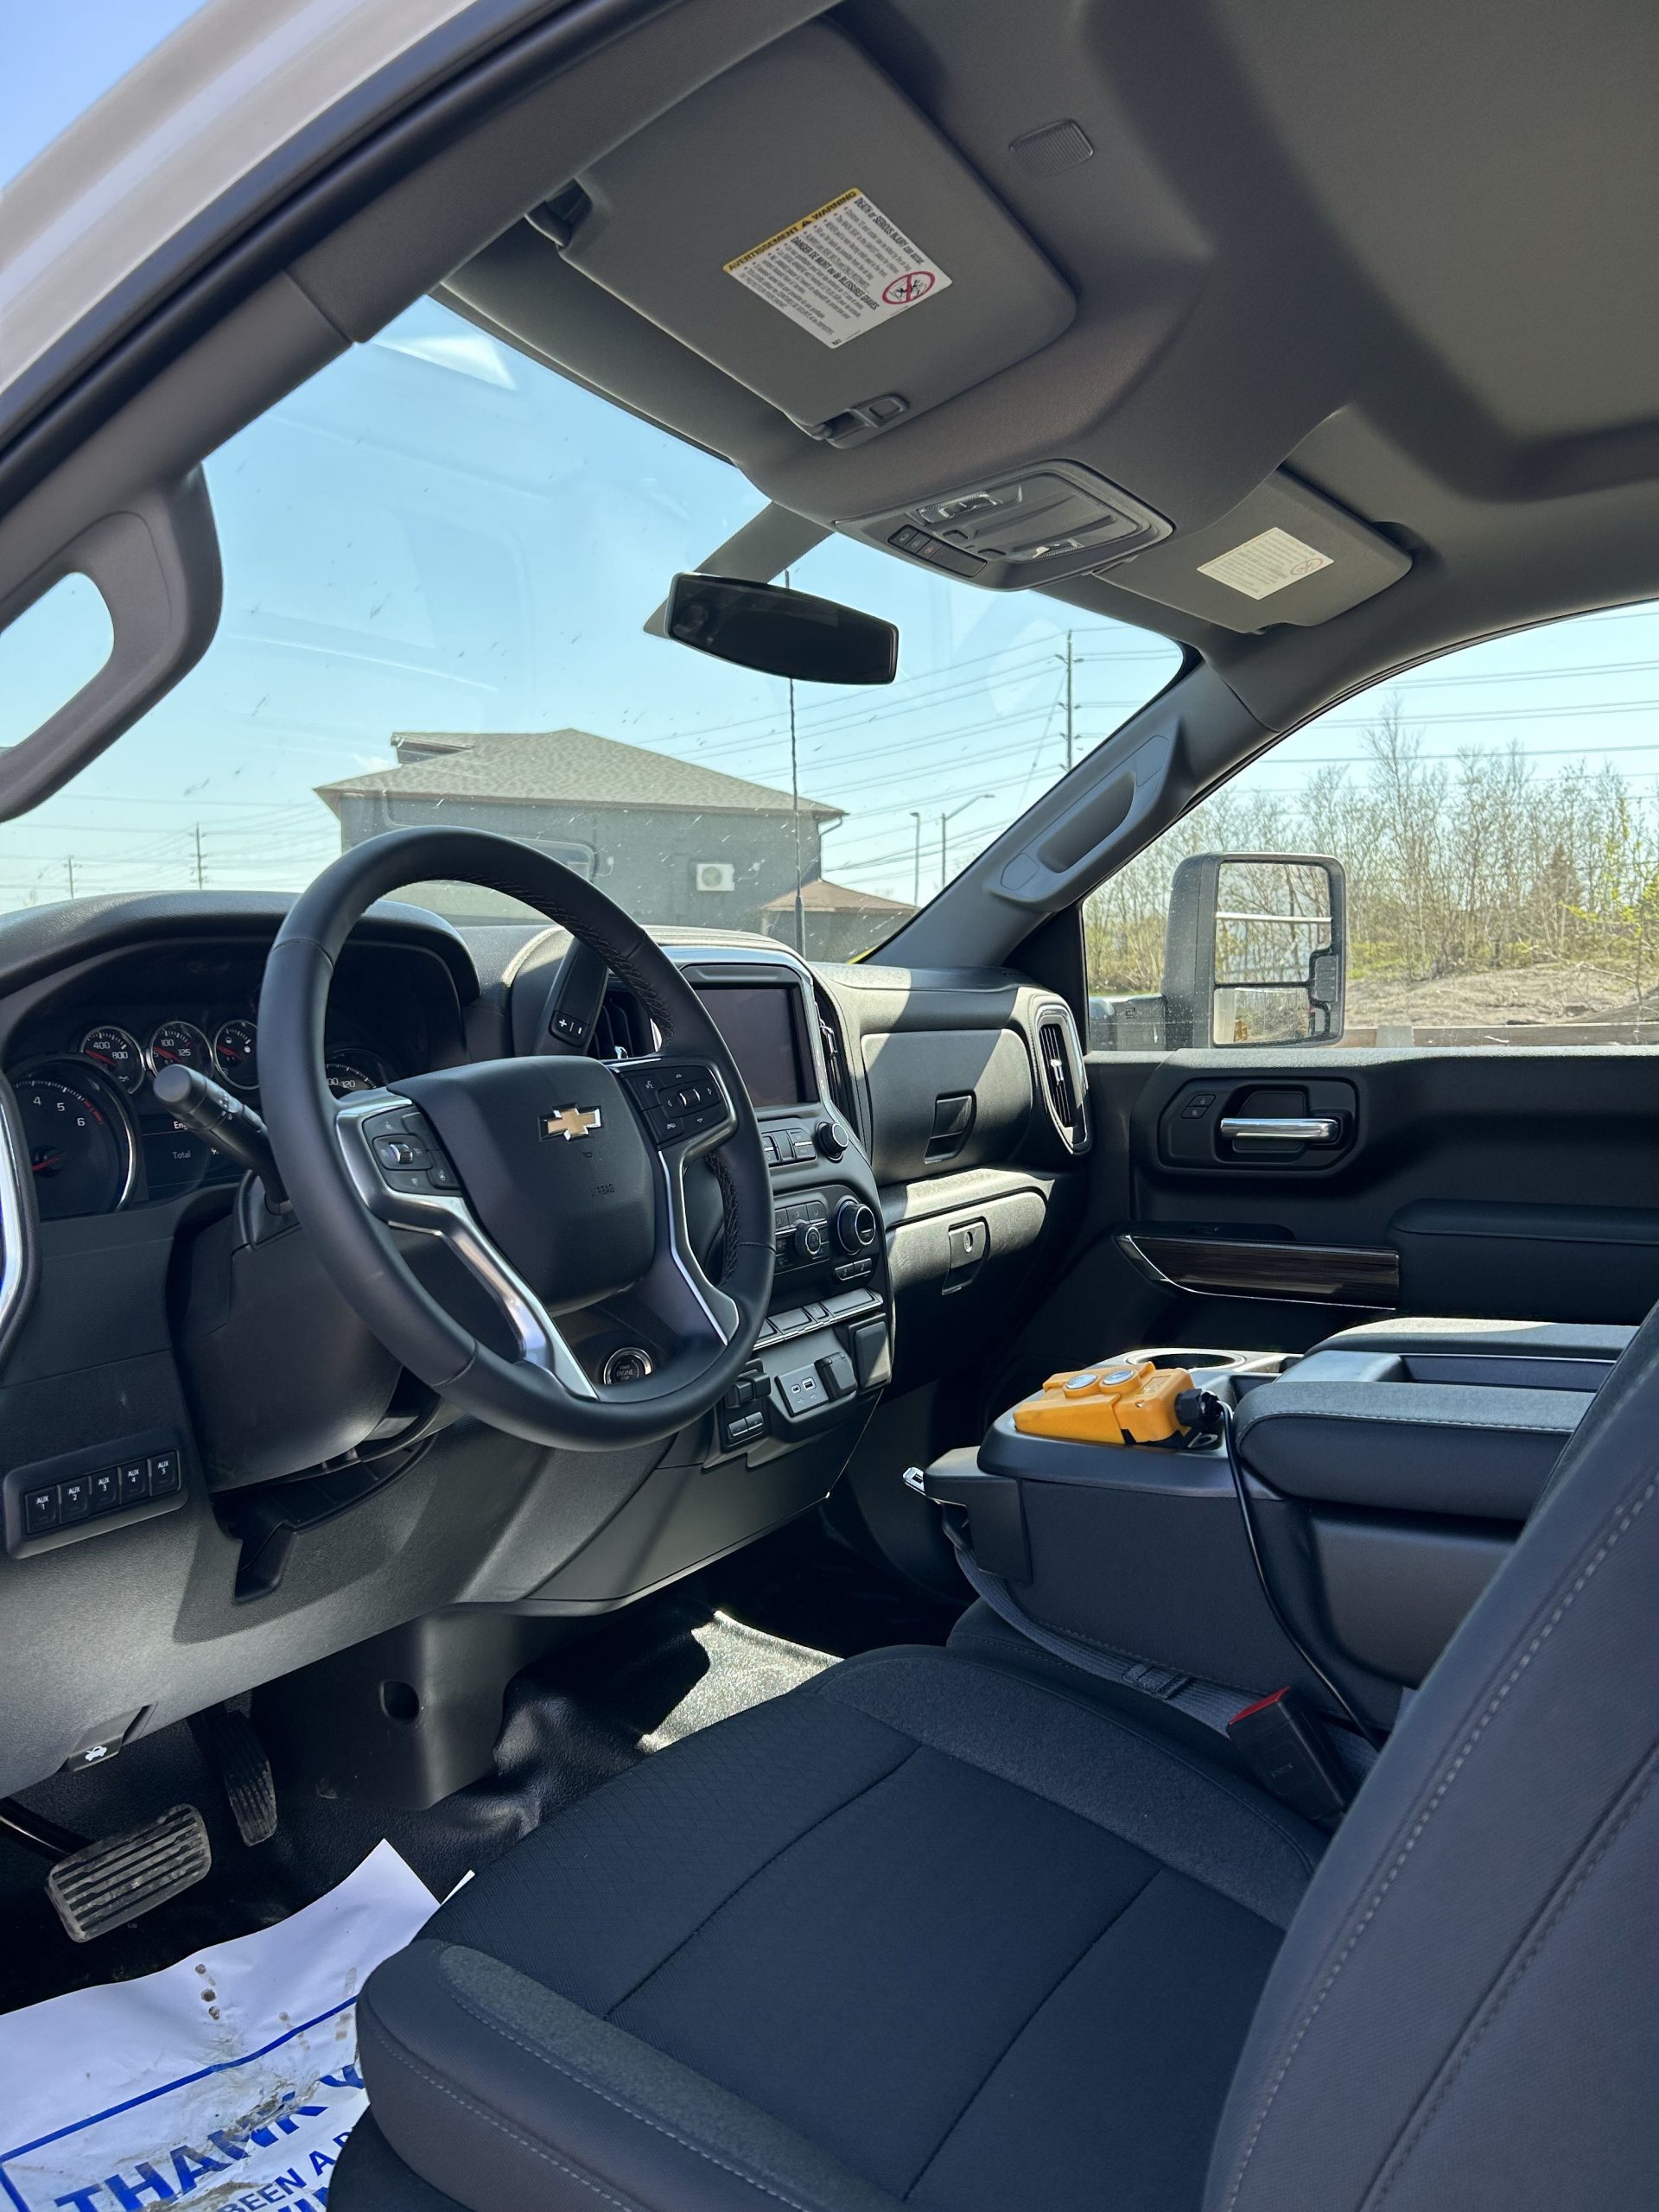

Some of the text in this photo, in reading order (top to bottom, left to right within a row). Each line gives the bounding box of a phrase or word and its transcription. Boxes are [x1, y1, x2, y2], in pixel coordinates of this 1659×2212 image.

[853, 197, 874, 214] DEATH
[871, 214, 895, 234] SERIOUS
[728, 227, 799, 270] AVERTISSEMENT
[811, 191, 857, 220] WARNING
[790, 236, 814, 254] DANGER
[92, 1041, 111, 1050] 400
[161, 1039, 175, 1047] 100
[111, 1051, 128, 1060] 800
[178, 1048, 192, 1057] 125
[341, 1080, 356, 1089] 120
[33, 1096, 42, 1106] 4
[56, 1102, 66, 1112] 5
[77, 1117, 86, 1127] 6
[172, 1150, 192, 1160] Total
[157, 1460, 168, 1469] AUX
[127, 1468, 140, 1478] AUX
[98, 1477, 110, 1486] AUX
[68, 1485, 80, 1495] AUX
[35, 1495, 49, 1504] AUX
